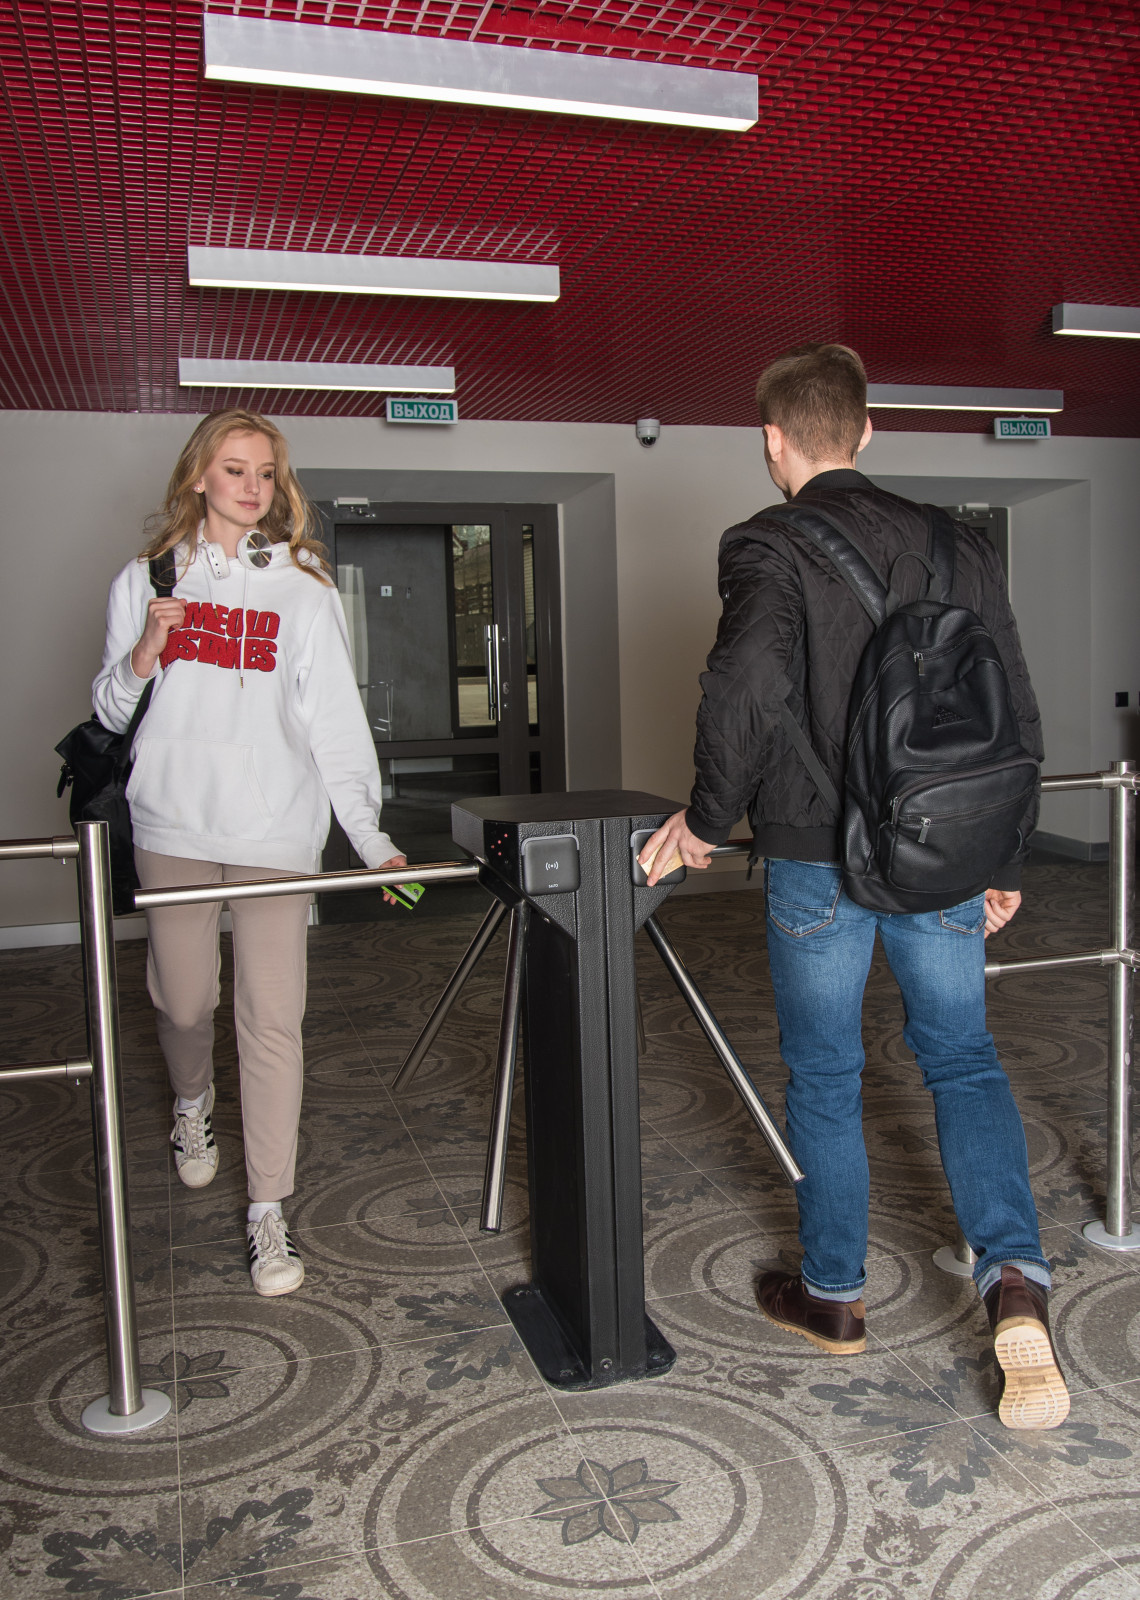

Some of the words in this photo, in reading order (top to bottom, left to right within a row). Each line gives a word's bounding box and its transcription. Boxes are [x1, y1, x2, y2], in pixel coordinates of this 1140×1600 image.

[393, 403, 451, 420] ВЫХОД
[1002, 422, 1045, 435] ВЫХОД
[226, 608, 280, 639] OLD
[159, 629, 277, 672] ISTAKES
